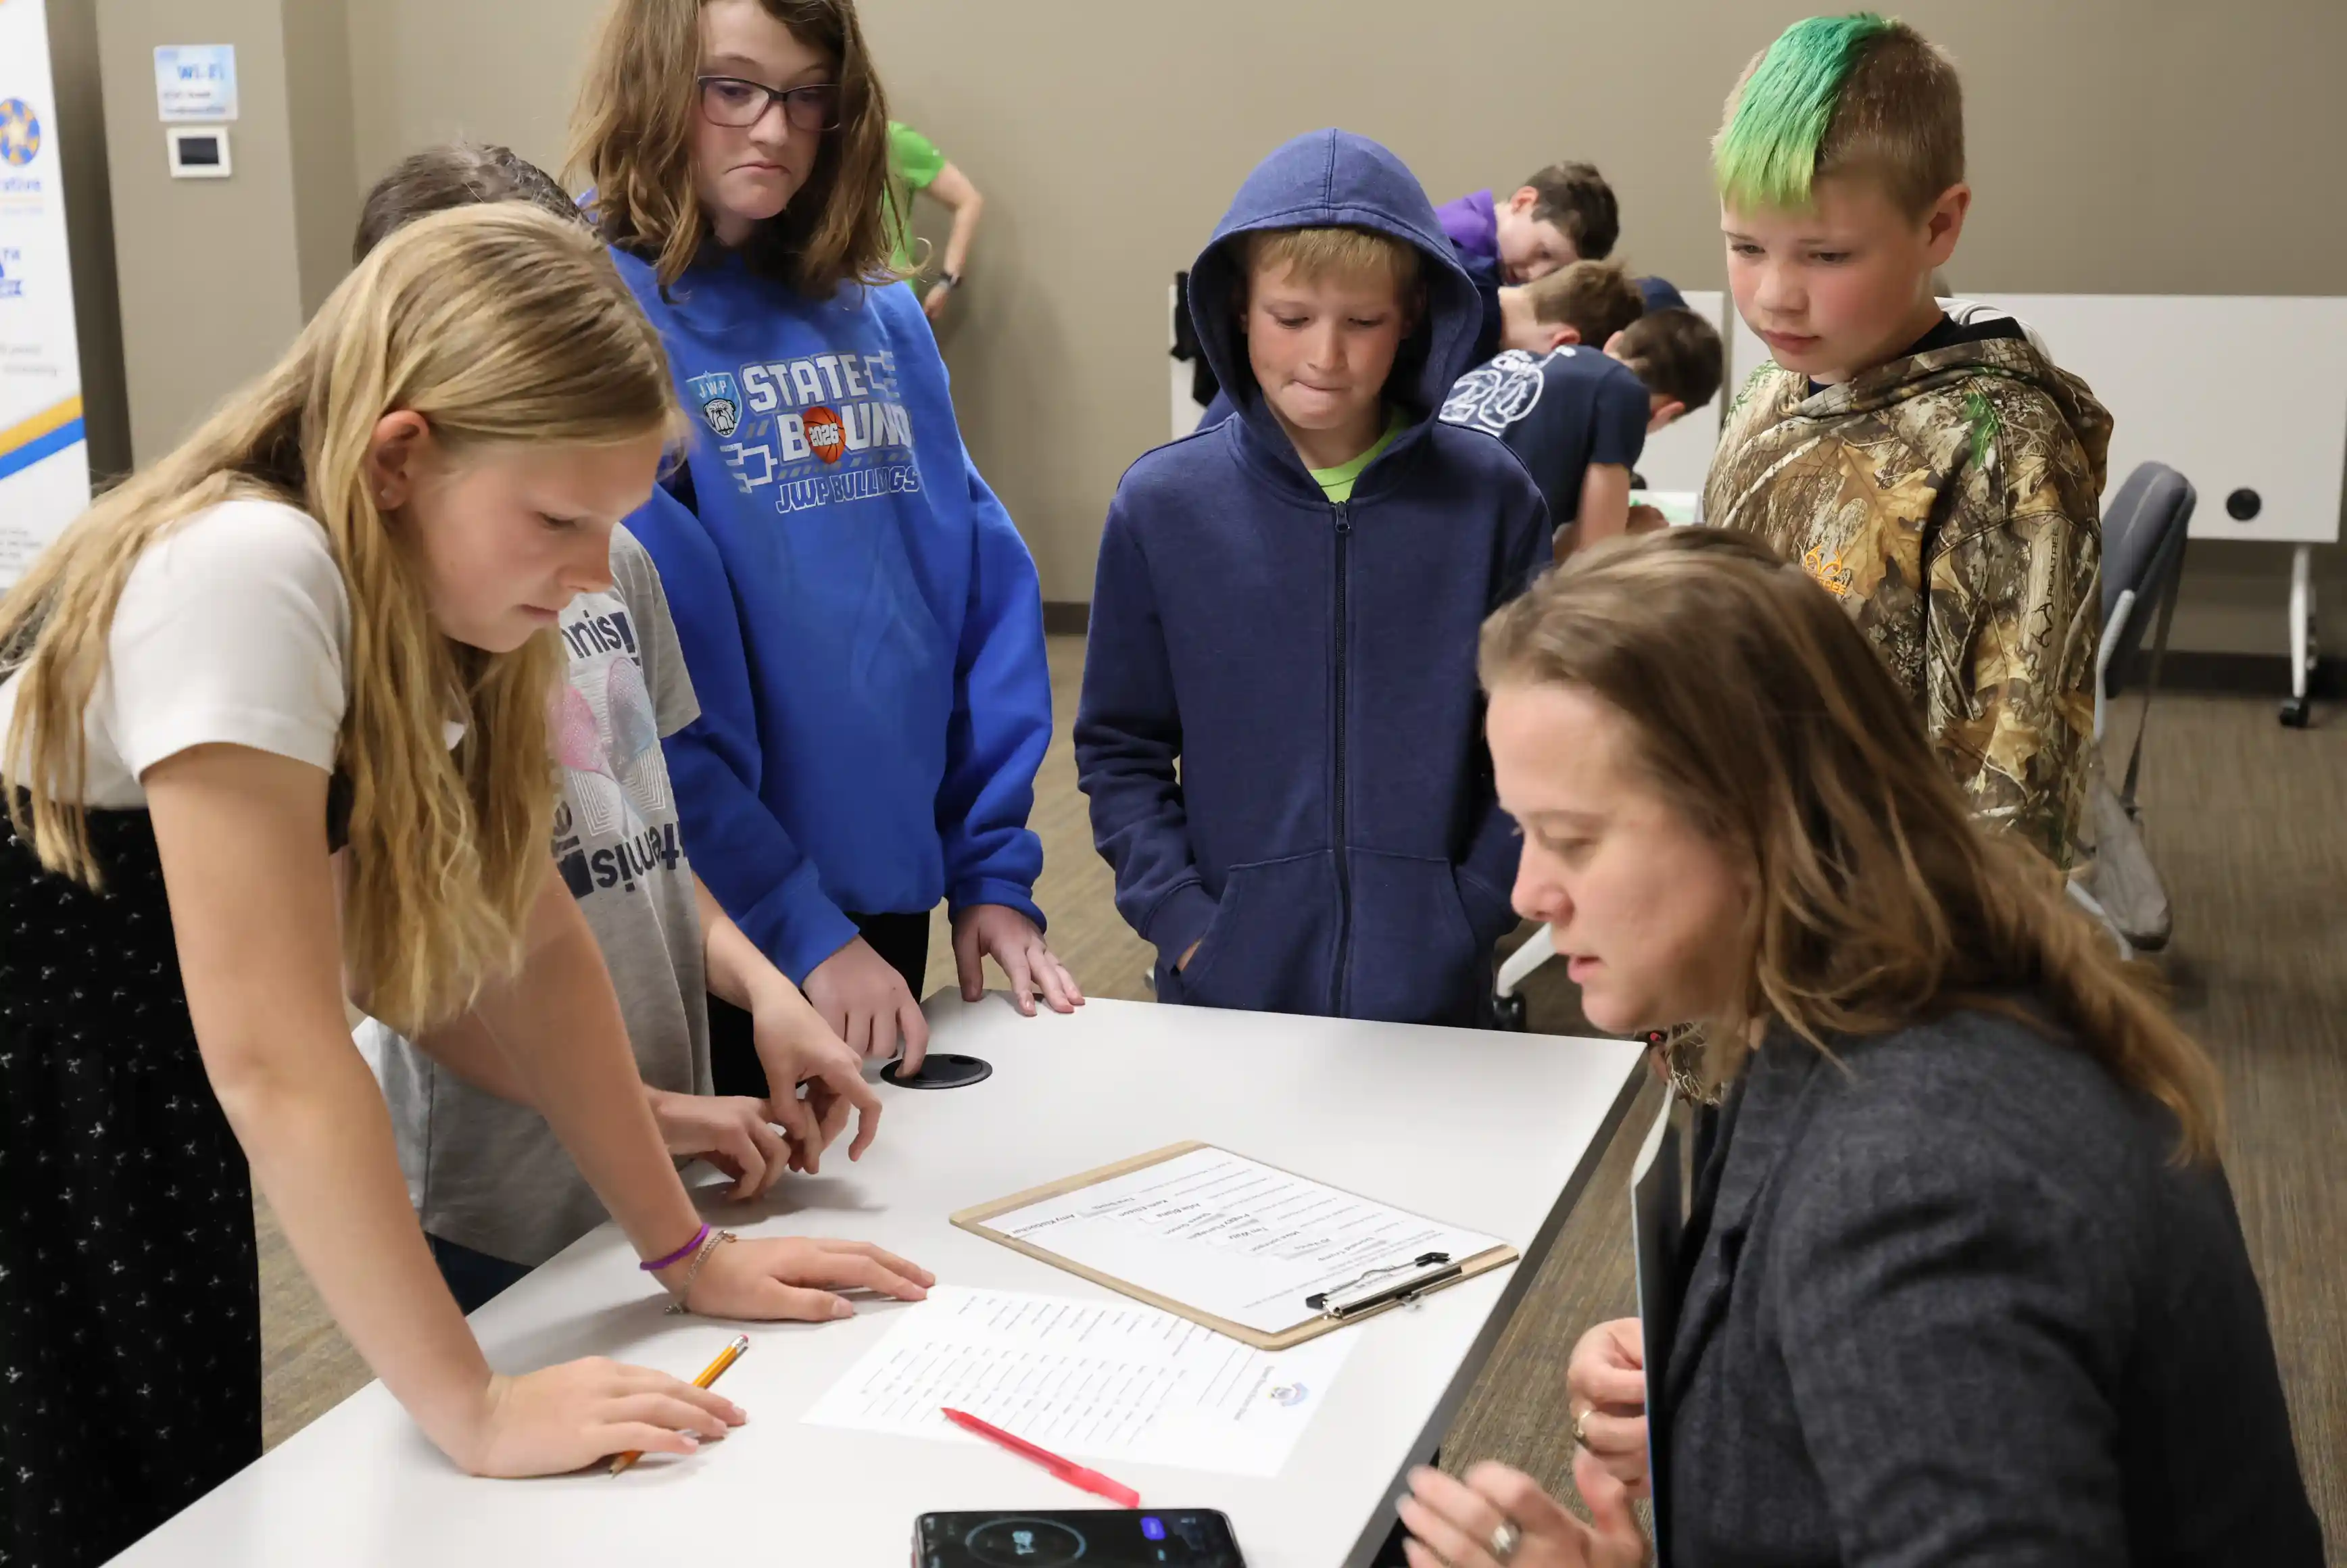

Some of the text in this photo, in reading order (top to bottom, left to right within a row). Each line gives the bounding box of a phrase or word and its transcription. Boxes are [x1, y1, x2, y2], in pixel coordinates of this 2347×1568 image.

[743, 354, 868, 412] STATE
[775, 477, 829, 514] JWP
[2046, 526, 2059, 597] REALTREE
